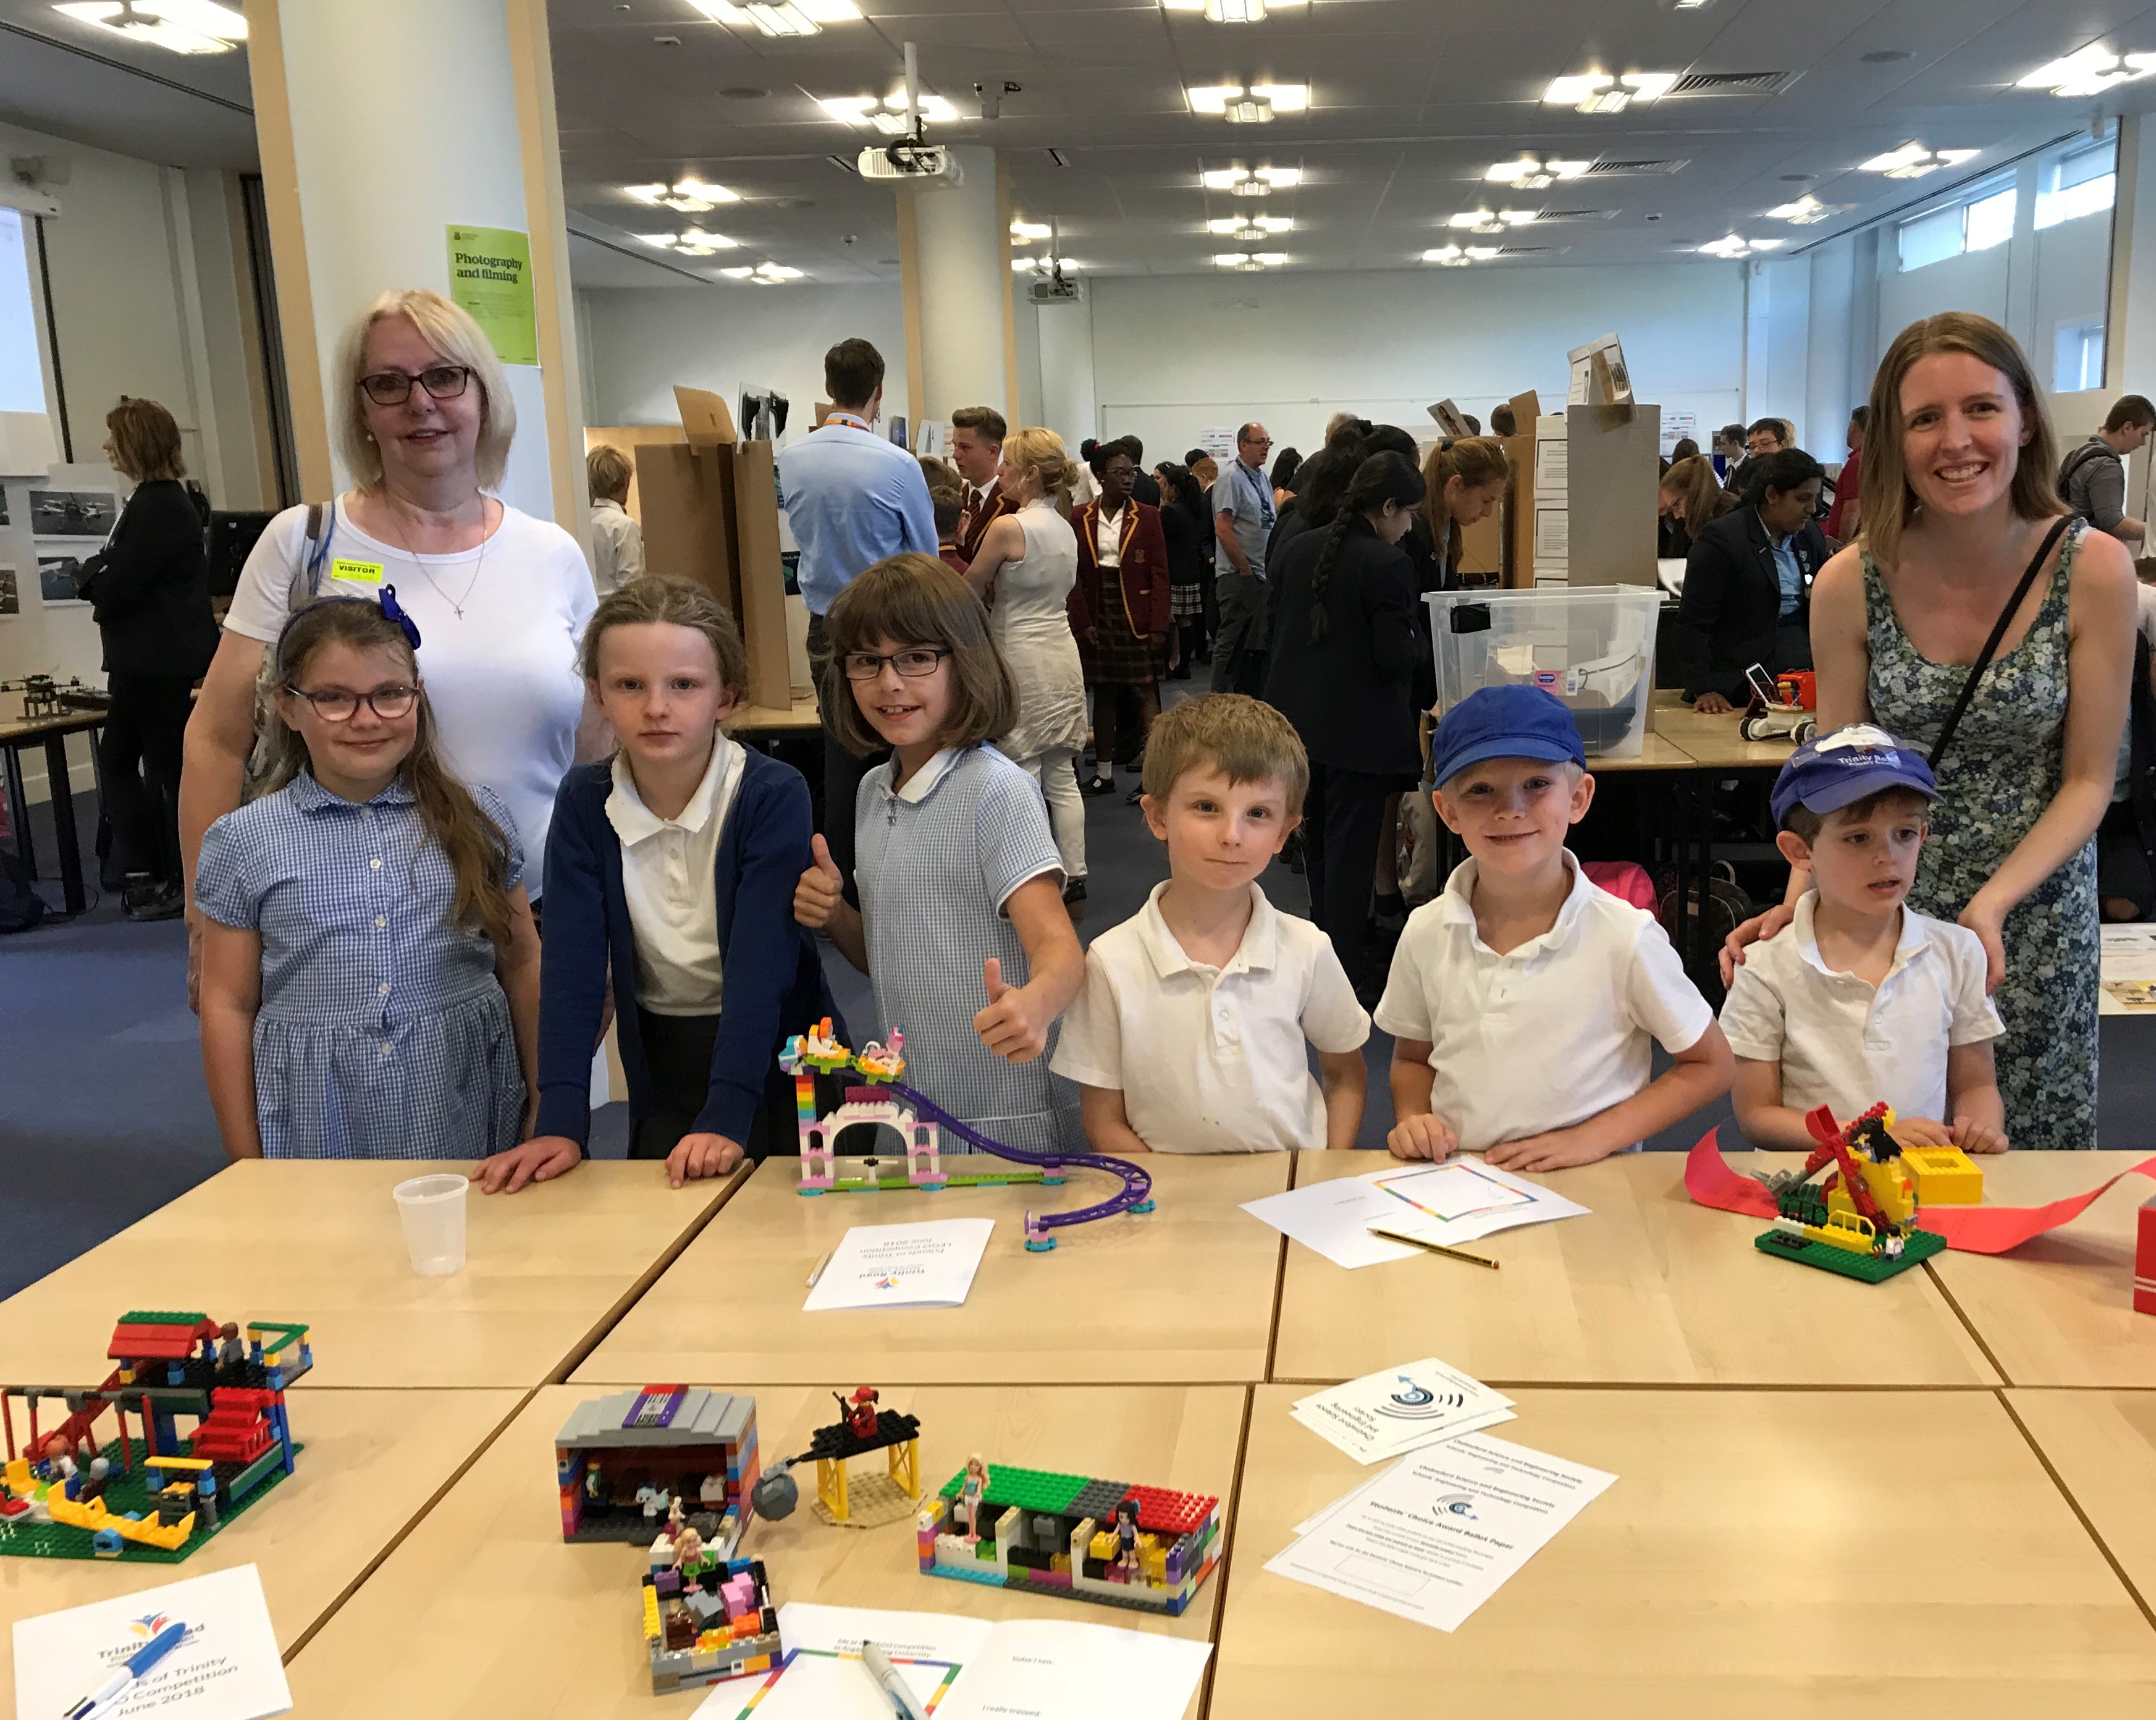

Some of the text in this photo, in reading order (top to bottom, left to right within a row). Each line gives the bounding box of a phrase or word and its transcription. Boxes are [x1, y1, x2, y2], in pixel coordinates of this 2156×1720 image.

[455, 253, 523, 271] Photography
[457, 268, 518, 284] and filming
[339, 565, 375, 574] VISITOR
[1837, 754, 1872, 764] Trinity
[97, 1640, 149, 1659] Trinit
[152, 1656, 227, 1683] of Trinity
[133, 1665, 238, 1700] Competition
[117, 1685, 205, 1718] June 2018
